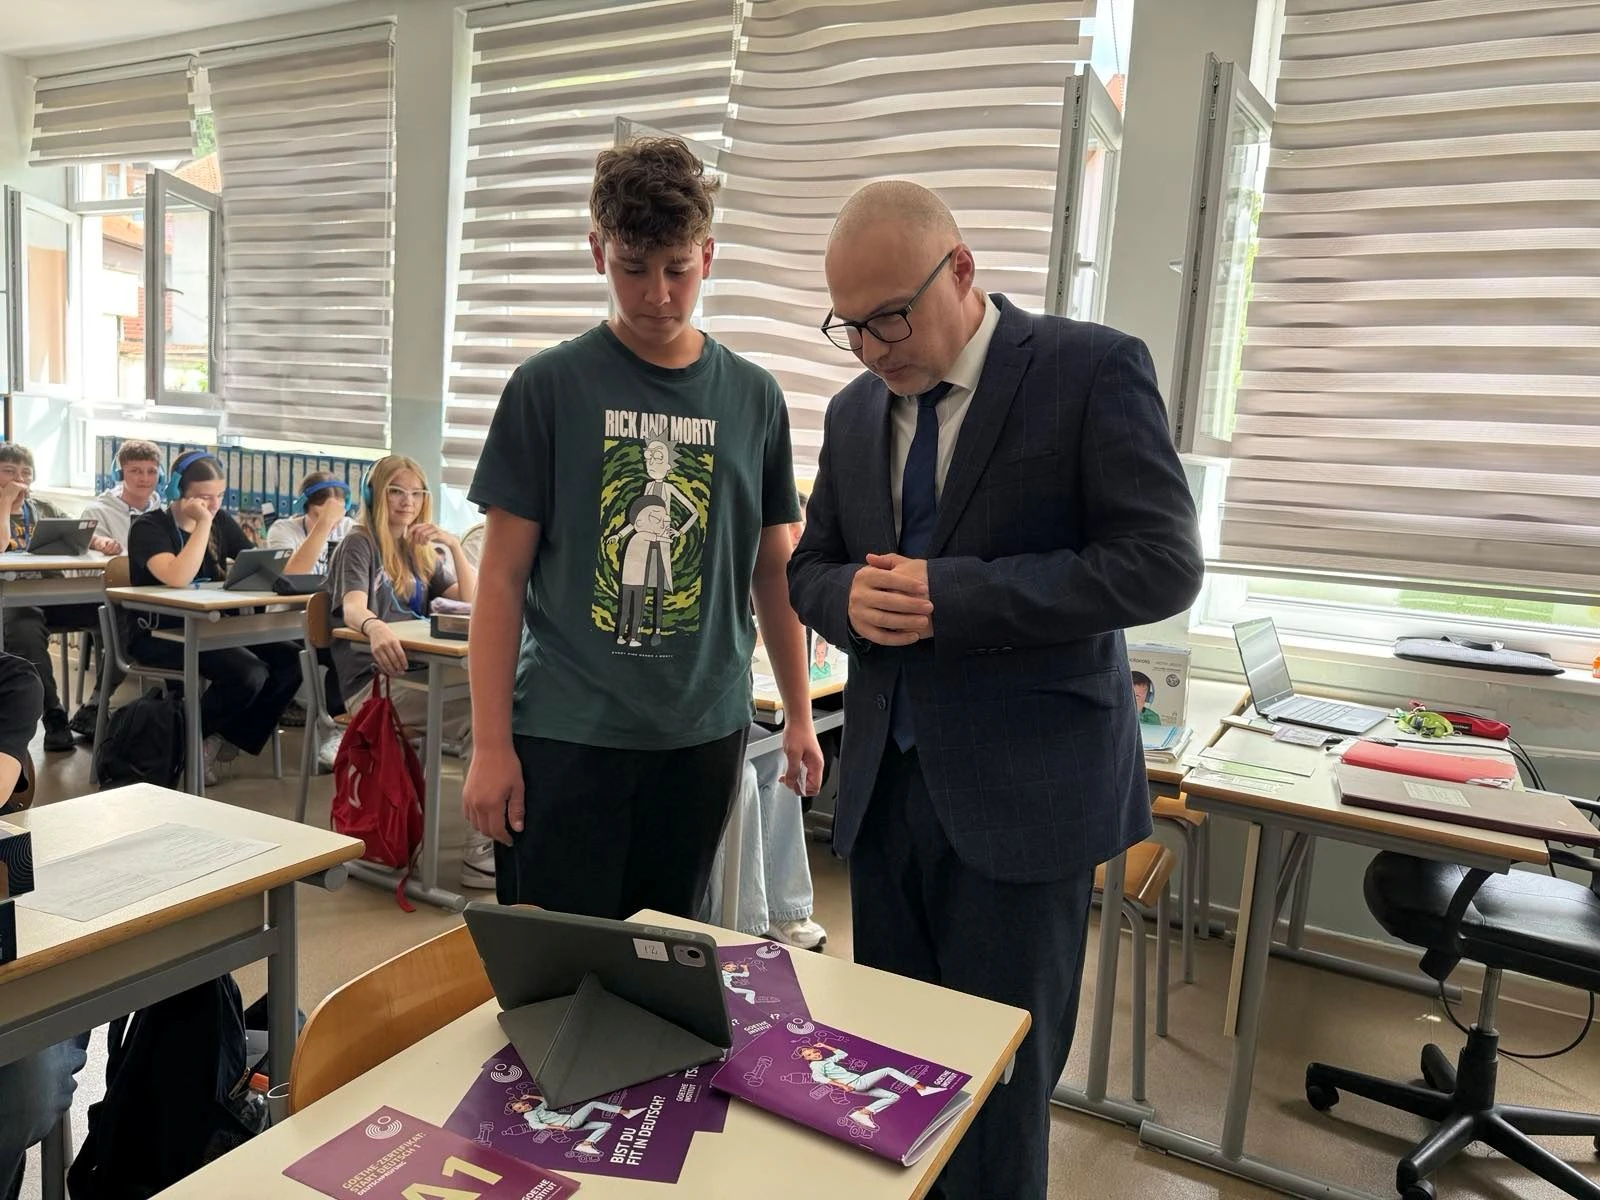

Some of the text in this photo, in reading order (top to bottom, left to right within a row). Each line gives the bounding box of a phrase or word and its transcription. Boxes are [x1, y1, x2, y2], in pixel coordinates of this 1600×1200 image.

[605, 409, 716, 446] RICK AND MORTY
[610, 1127, 637, 1164] BIST DU
[626, 1095, 666, 1165] FIT IN DEUTSCH?
[342, 1132, 426, 1189] GOETHE-ZERTIFIKAT:
[349, 1172, 378, 1193] START
[376, 1147, 416, 1174] DEUTSCH
[401, 1155, 503, 1200] A1
